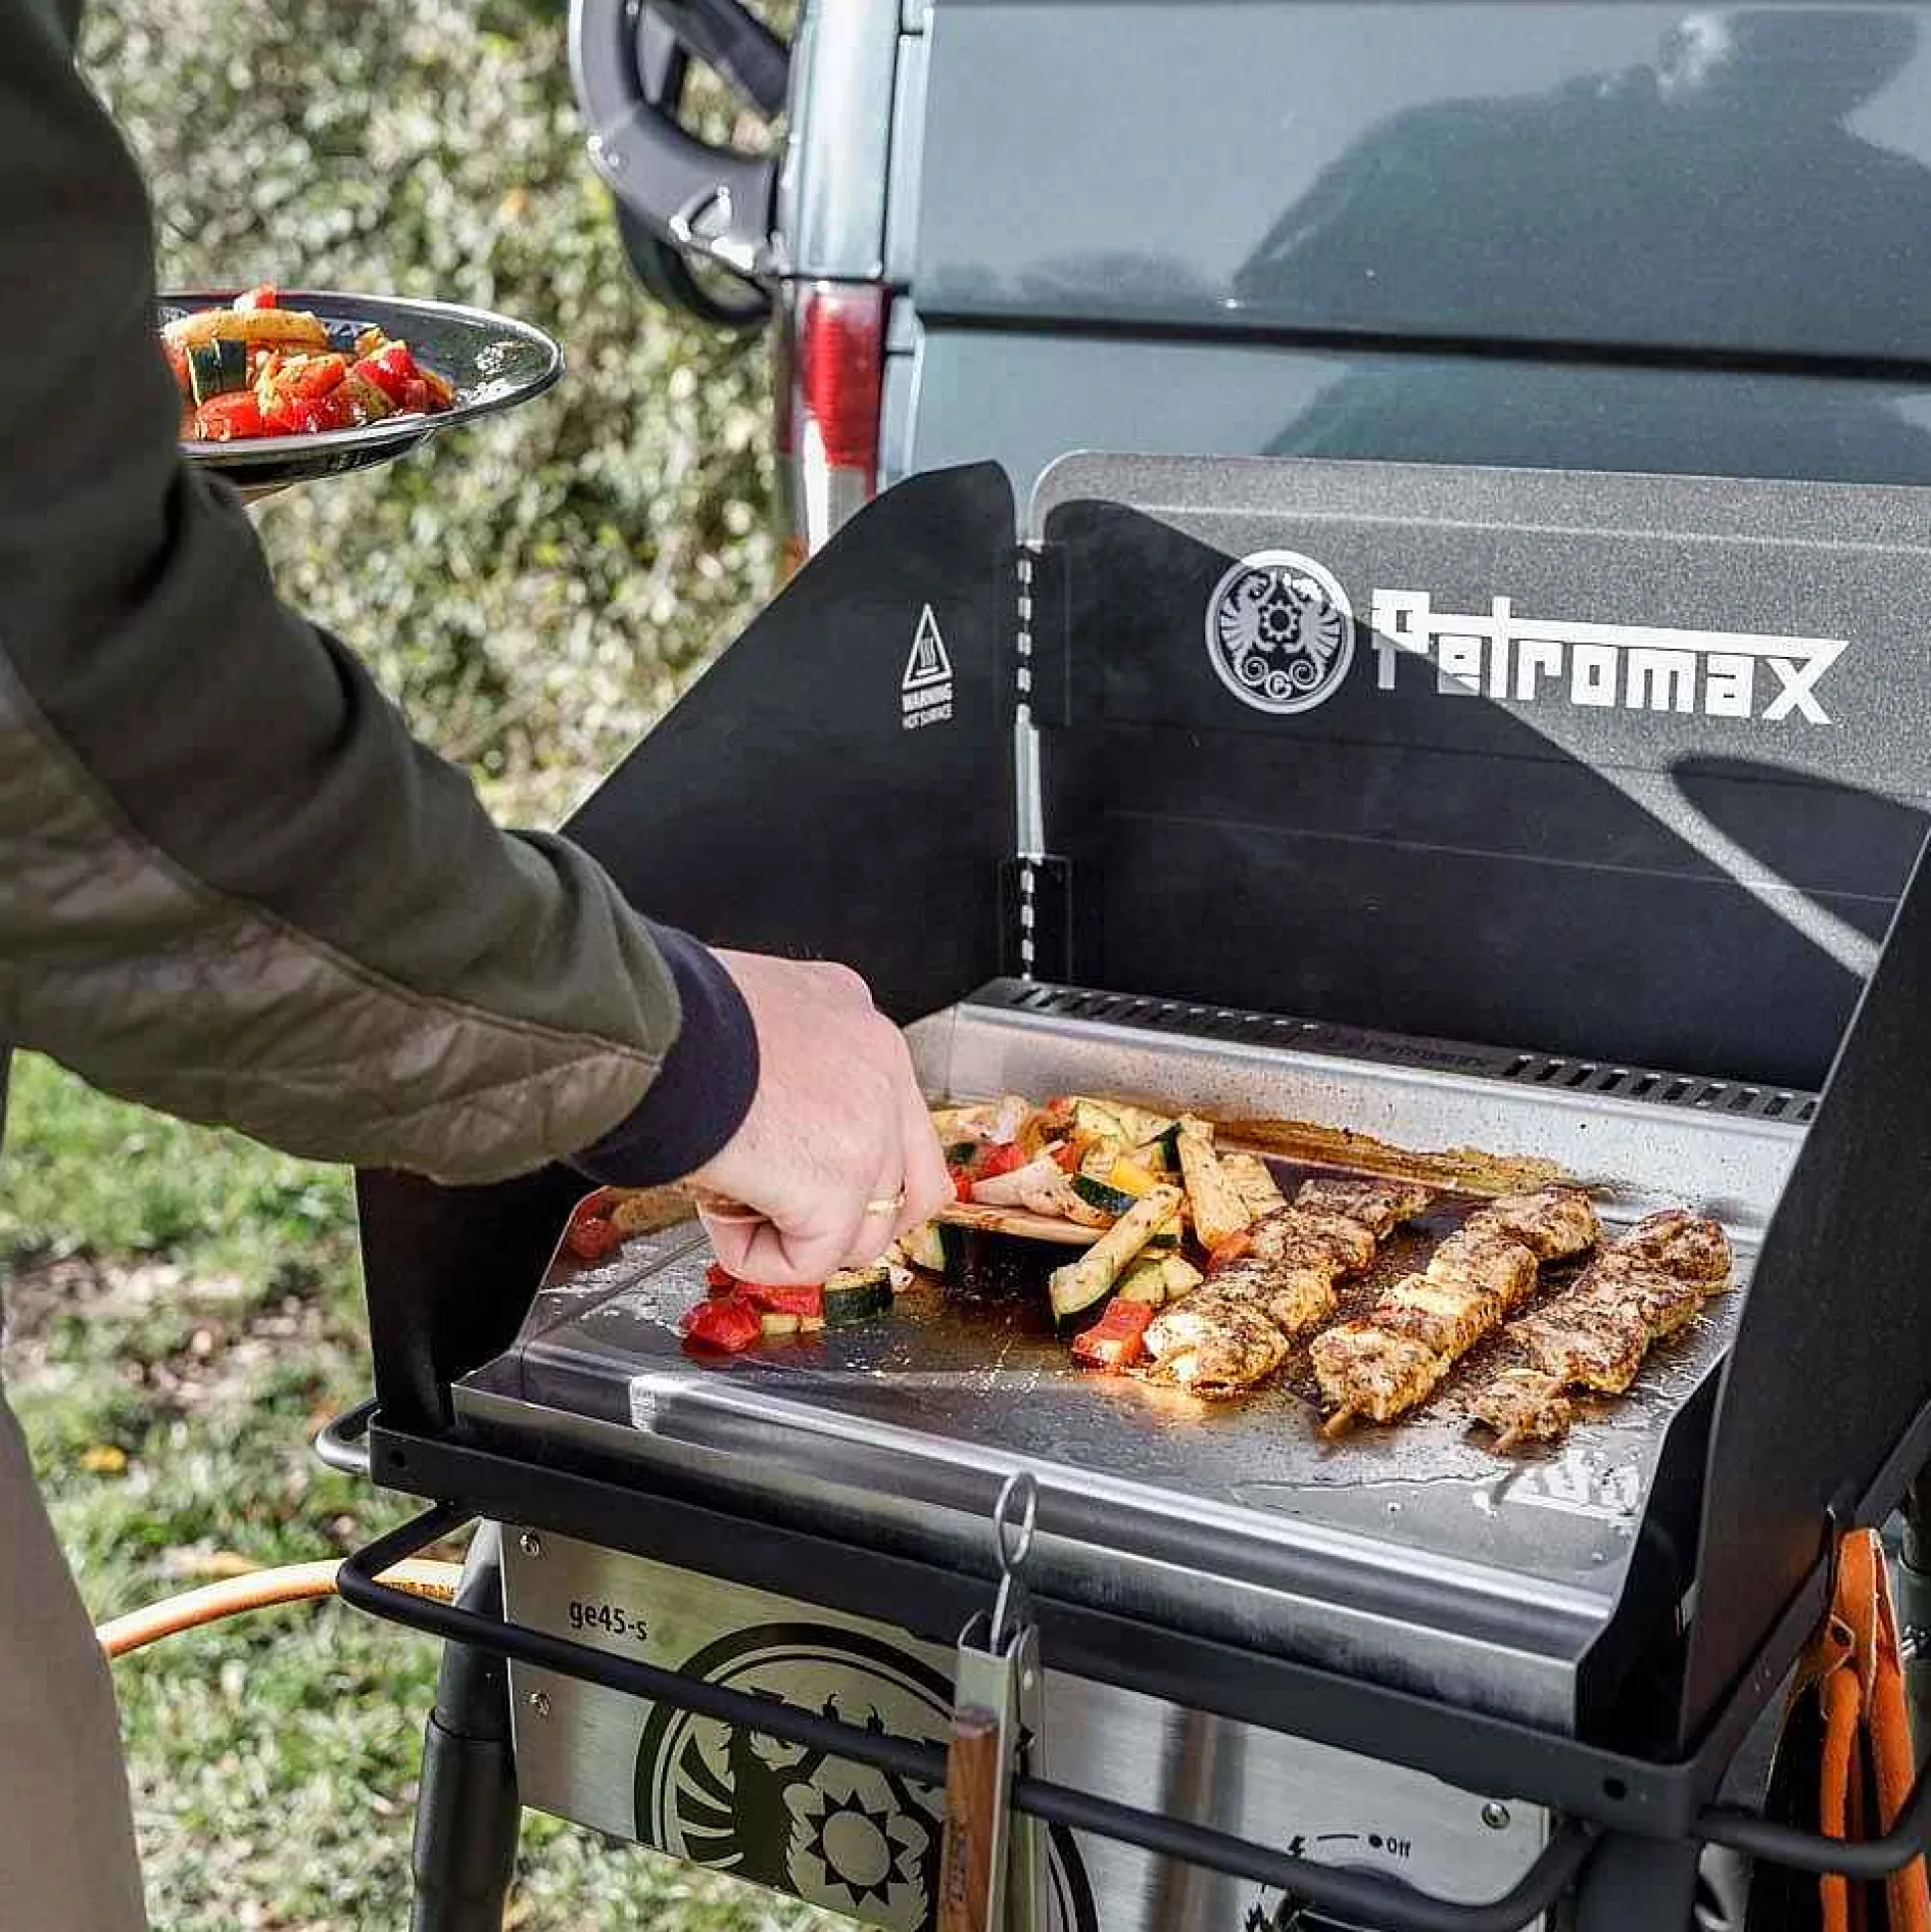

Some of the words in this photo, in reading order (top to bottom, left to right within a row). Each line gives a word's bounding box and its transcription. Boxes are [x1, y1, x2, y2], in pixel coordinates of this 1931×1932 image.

[1371, 588, 1849, 725] Petromax
[569, 1601, 647, 1641] ge45-s
[1387, 1836, 1411, 1858] Off
